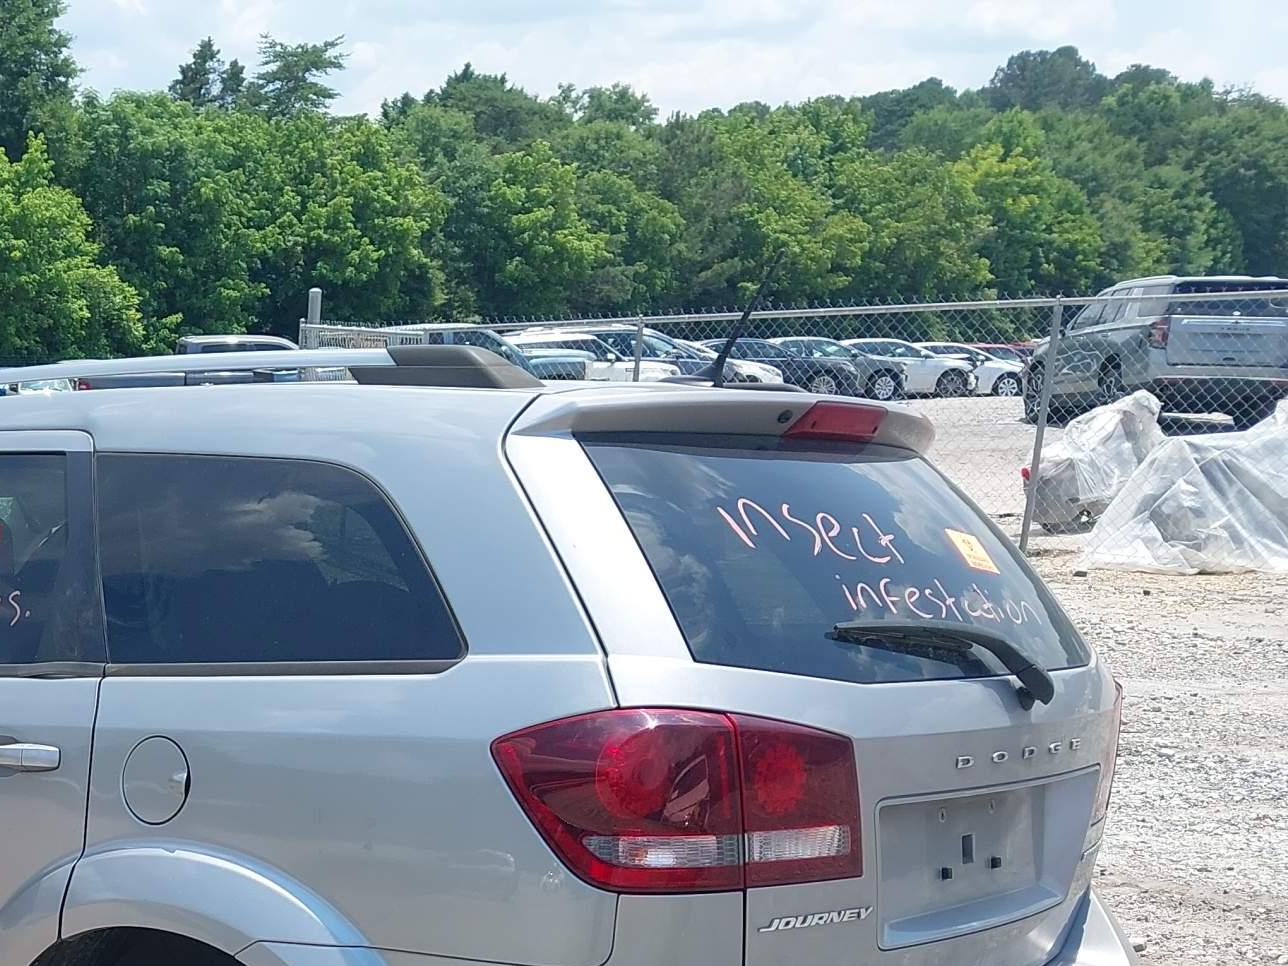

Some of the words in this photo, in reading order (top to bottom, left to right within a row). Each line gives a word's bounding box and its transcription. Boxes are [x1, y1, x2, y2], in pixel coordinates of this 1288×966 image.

[717, 497, 904, 564] Insect
[835, 574, 1041, 624] infestation
[955, 737, 1082, 769] DODGE
[758, 906, 873, 932] JOURNEY
